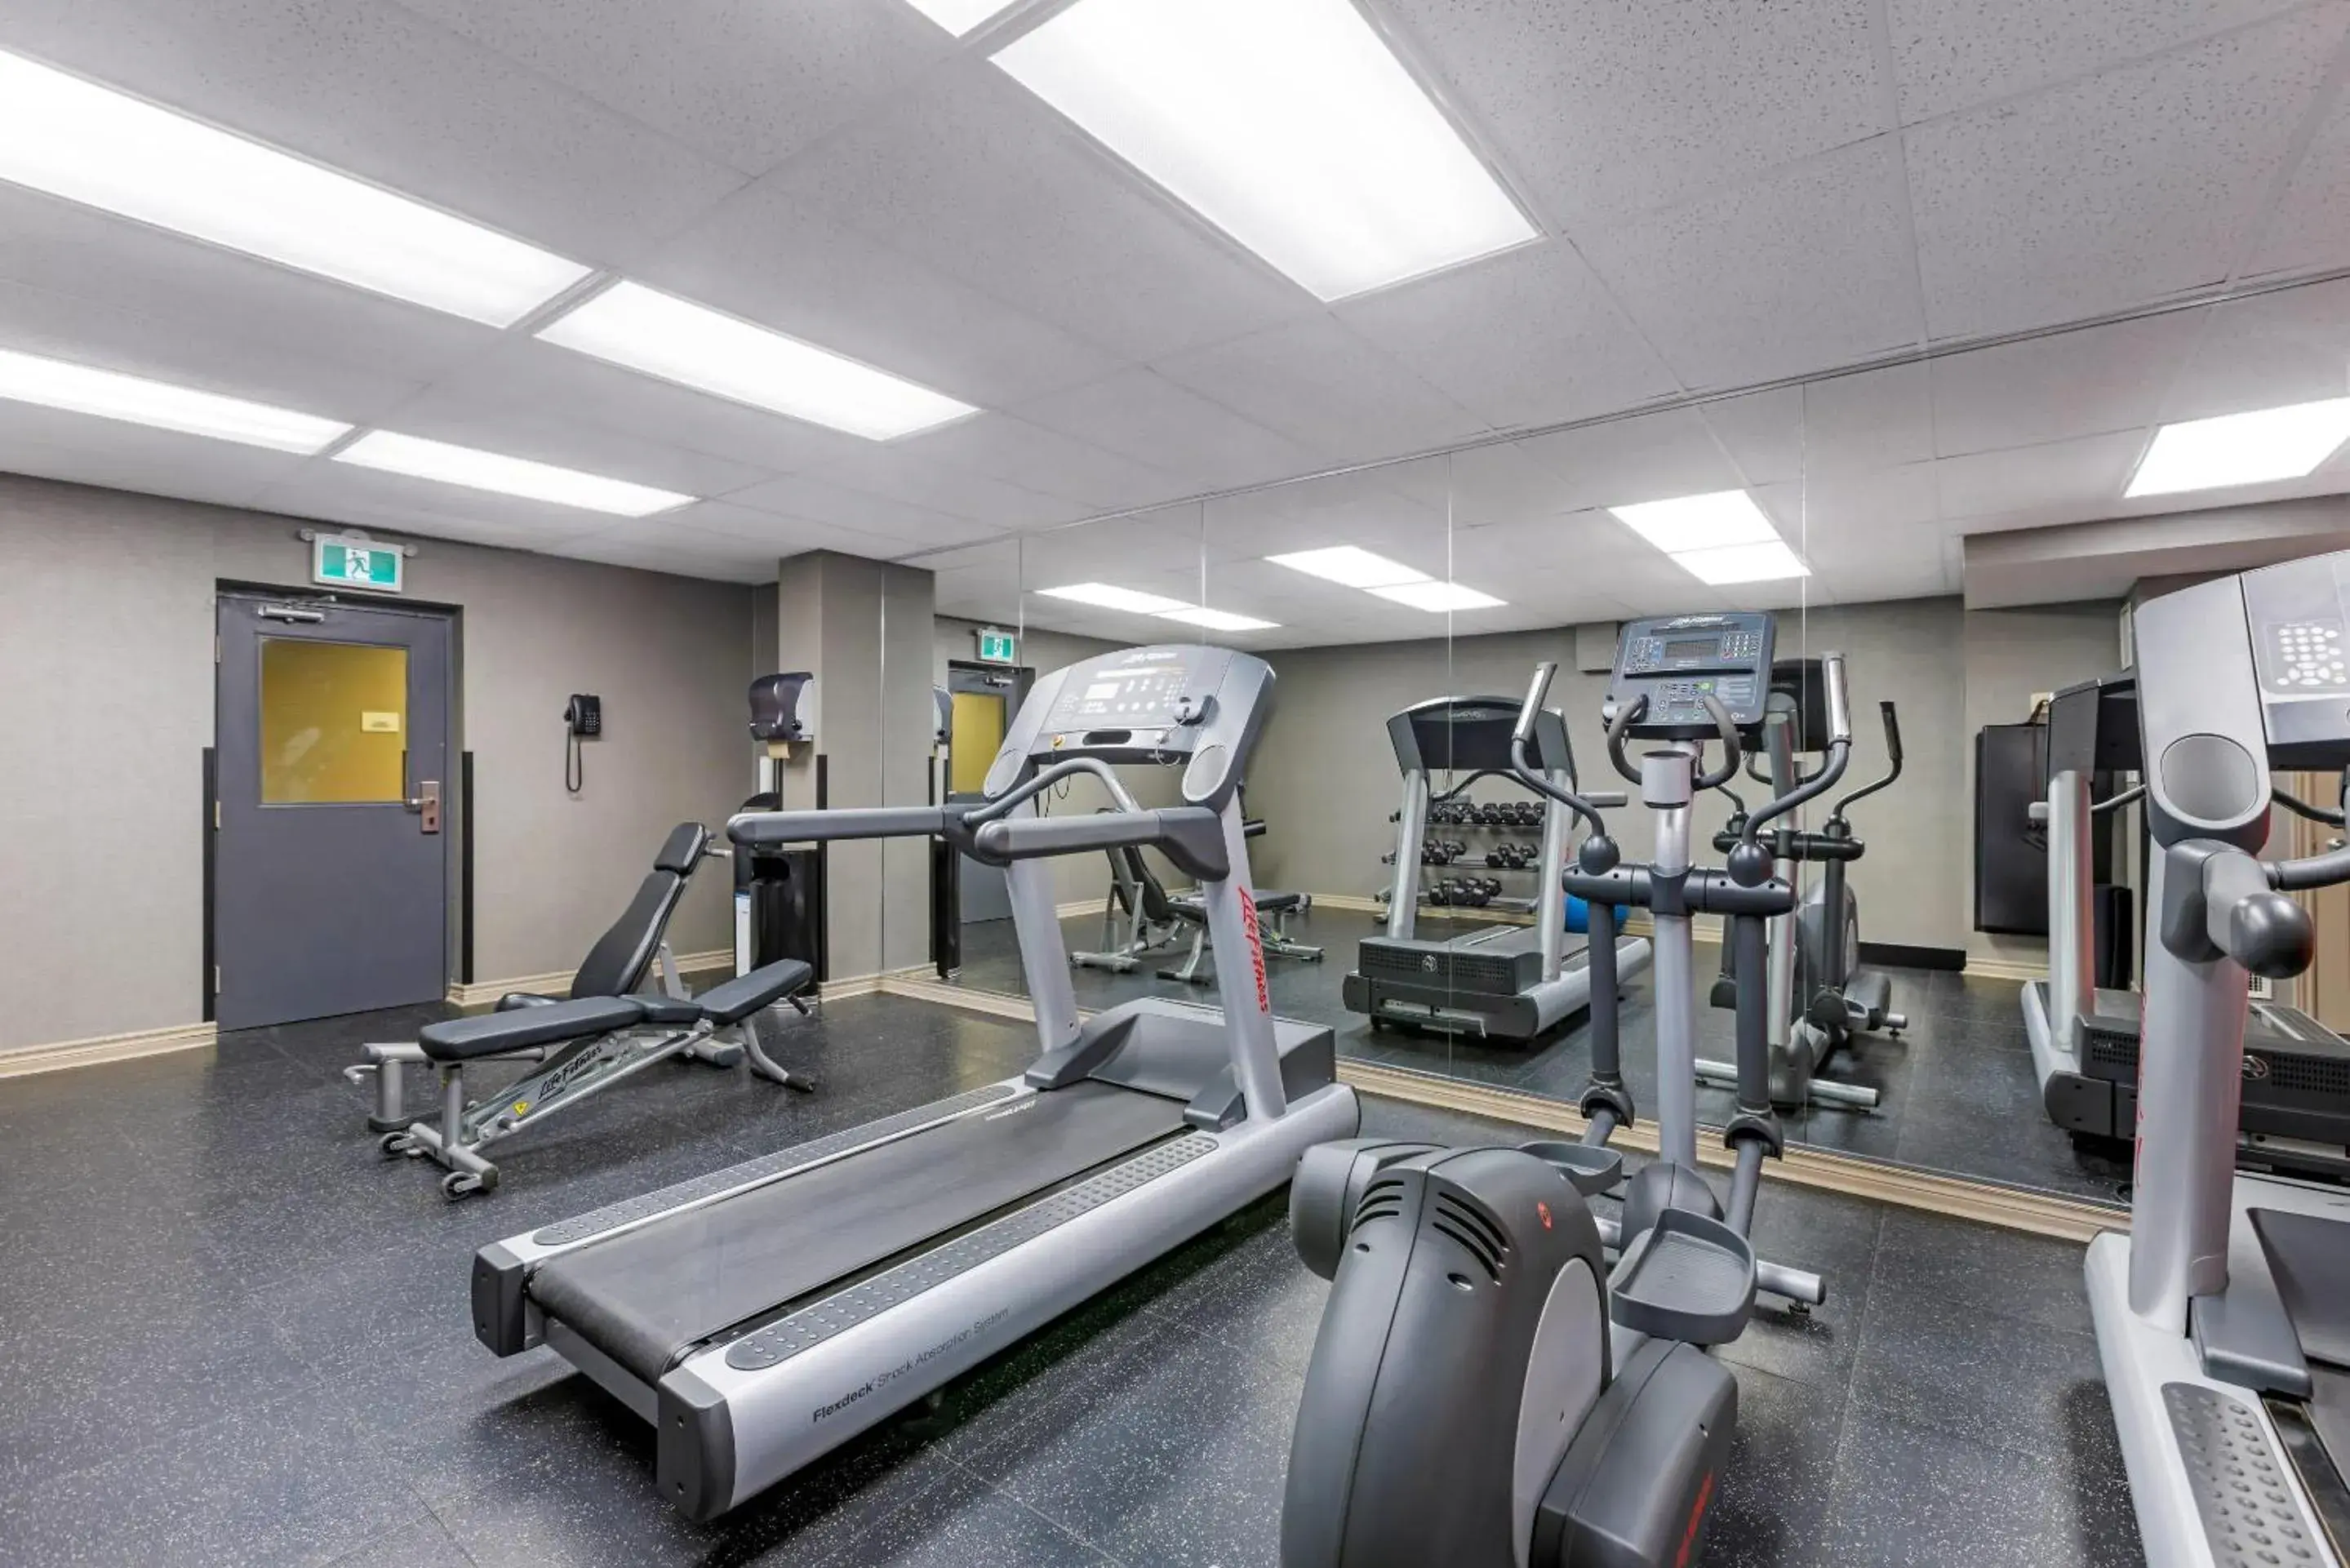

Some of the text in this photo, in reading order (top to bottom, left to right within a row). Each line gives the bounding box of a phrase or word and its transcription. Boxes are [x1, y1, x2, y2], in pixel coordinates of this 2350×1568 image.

[812, 1308, 1009, 1424] Flexdeck Shock Absorption System
